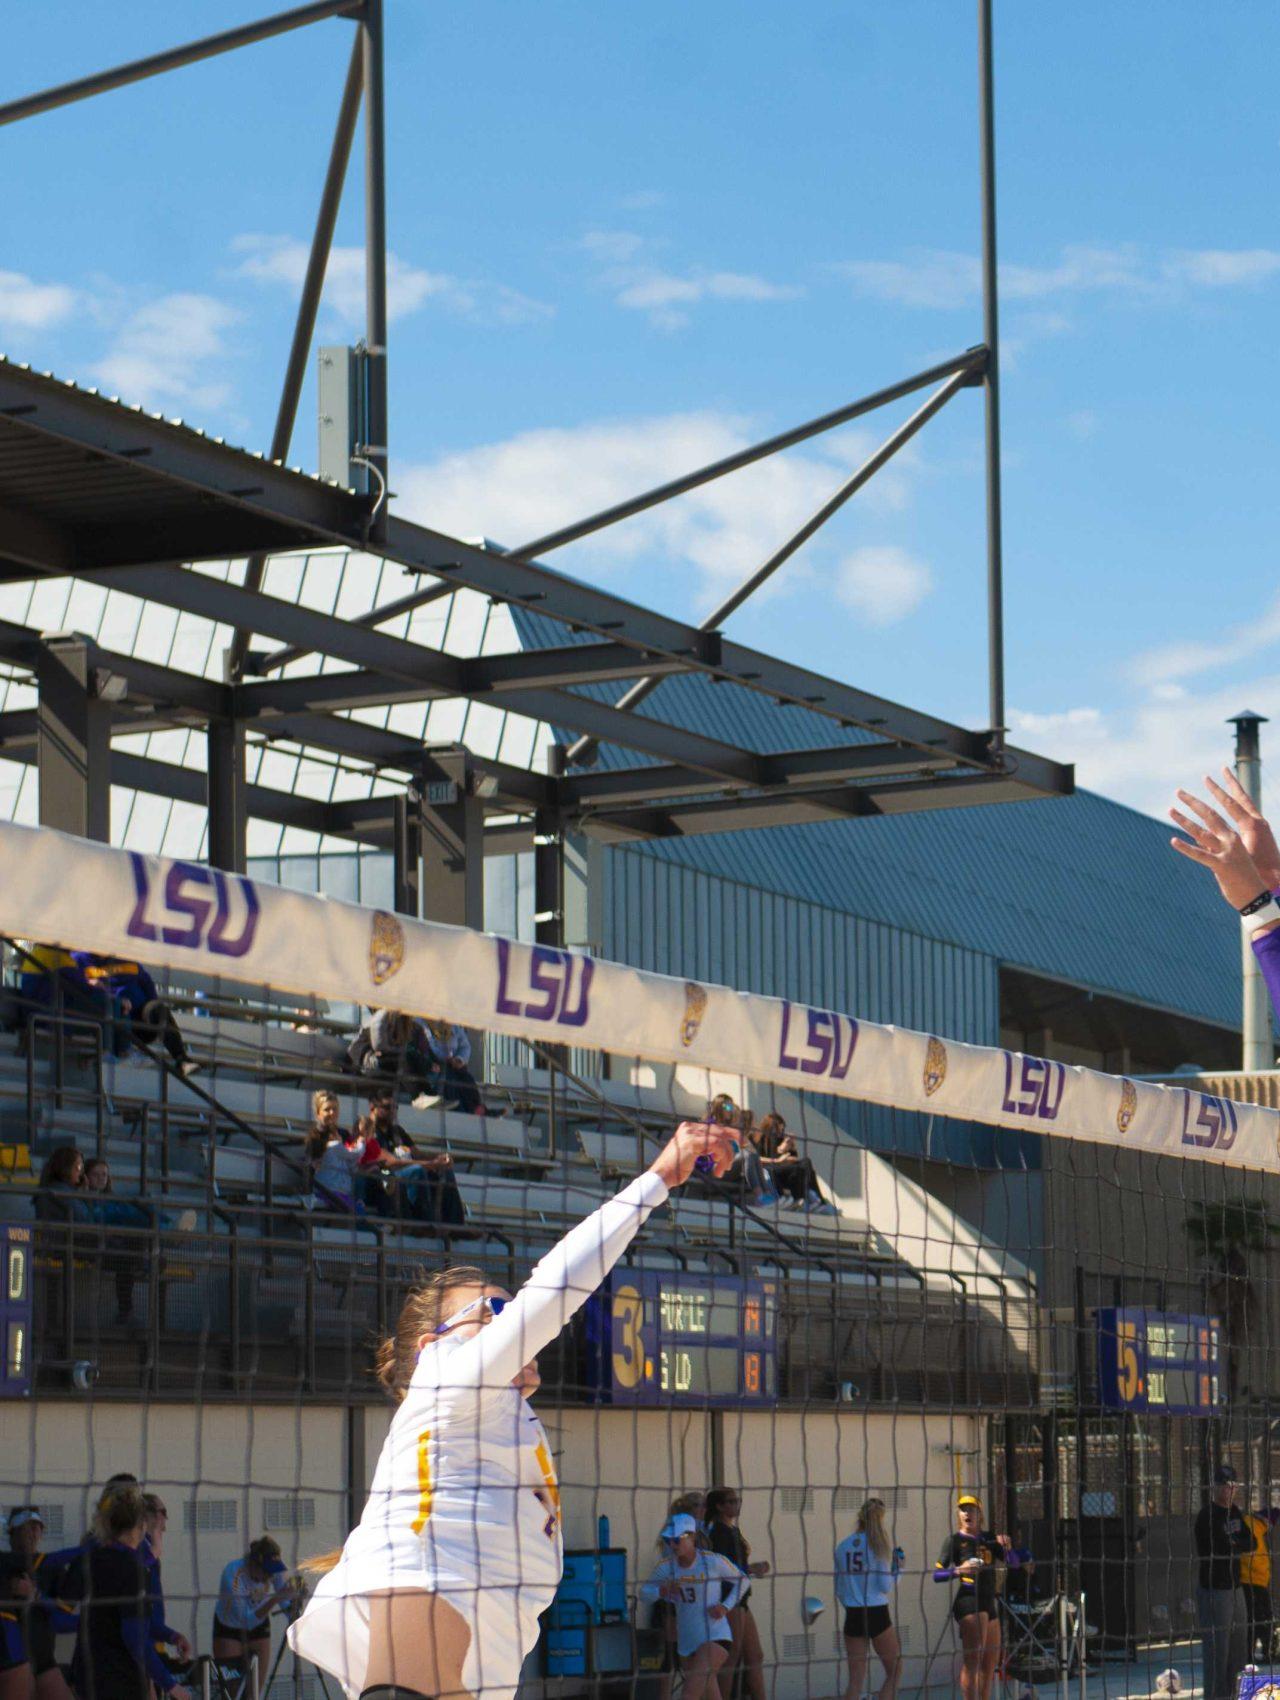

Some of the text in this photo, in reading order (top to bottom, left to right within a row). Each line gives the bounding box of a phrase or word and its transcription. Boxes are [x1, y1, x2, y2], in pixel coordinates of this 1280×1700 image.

[127, 851, 260, 957] LSU
[496, 937, 595, 1027] LSU
[779, 1001, 859, 1079] LSU
[1002, 1051, 1065, 1119] LSU
[1182, 1089, 1238, 1151] LSU
[8, 1227, 30, 1241] WON
[612, 1285, 645, 1388] 3
[1117, 1321, 1138, 1402] 5
[845, 1551, 863, 1573] 15
